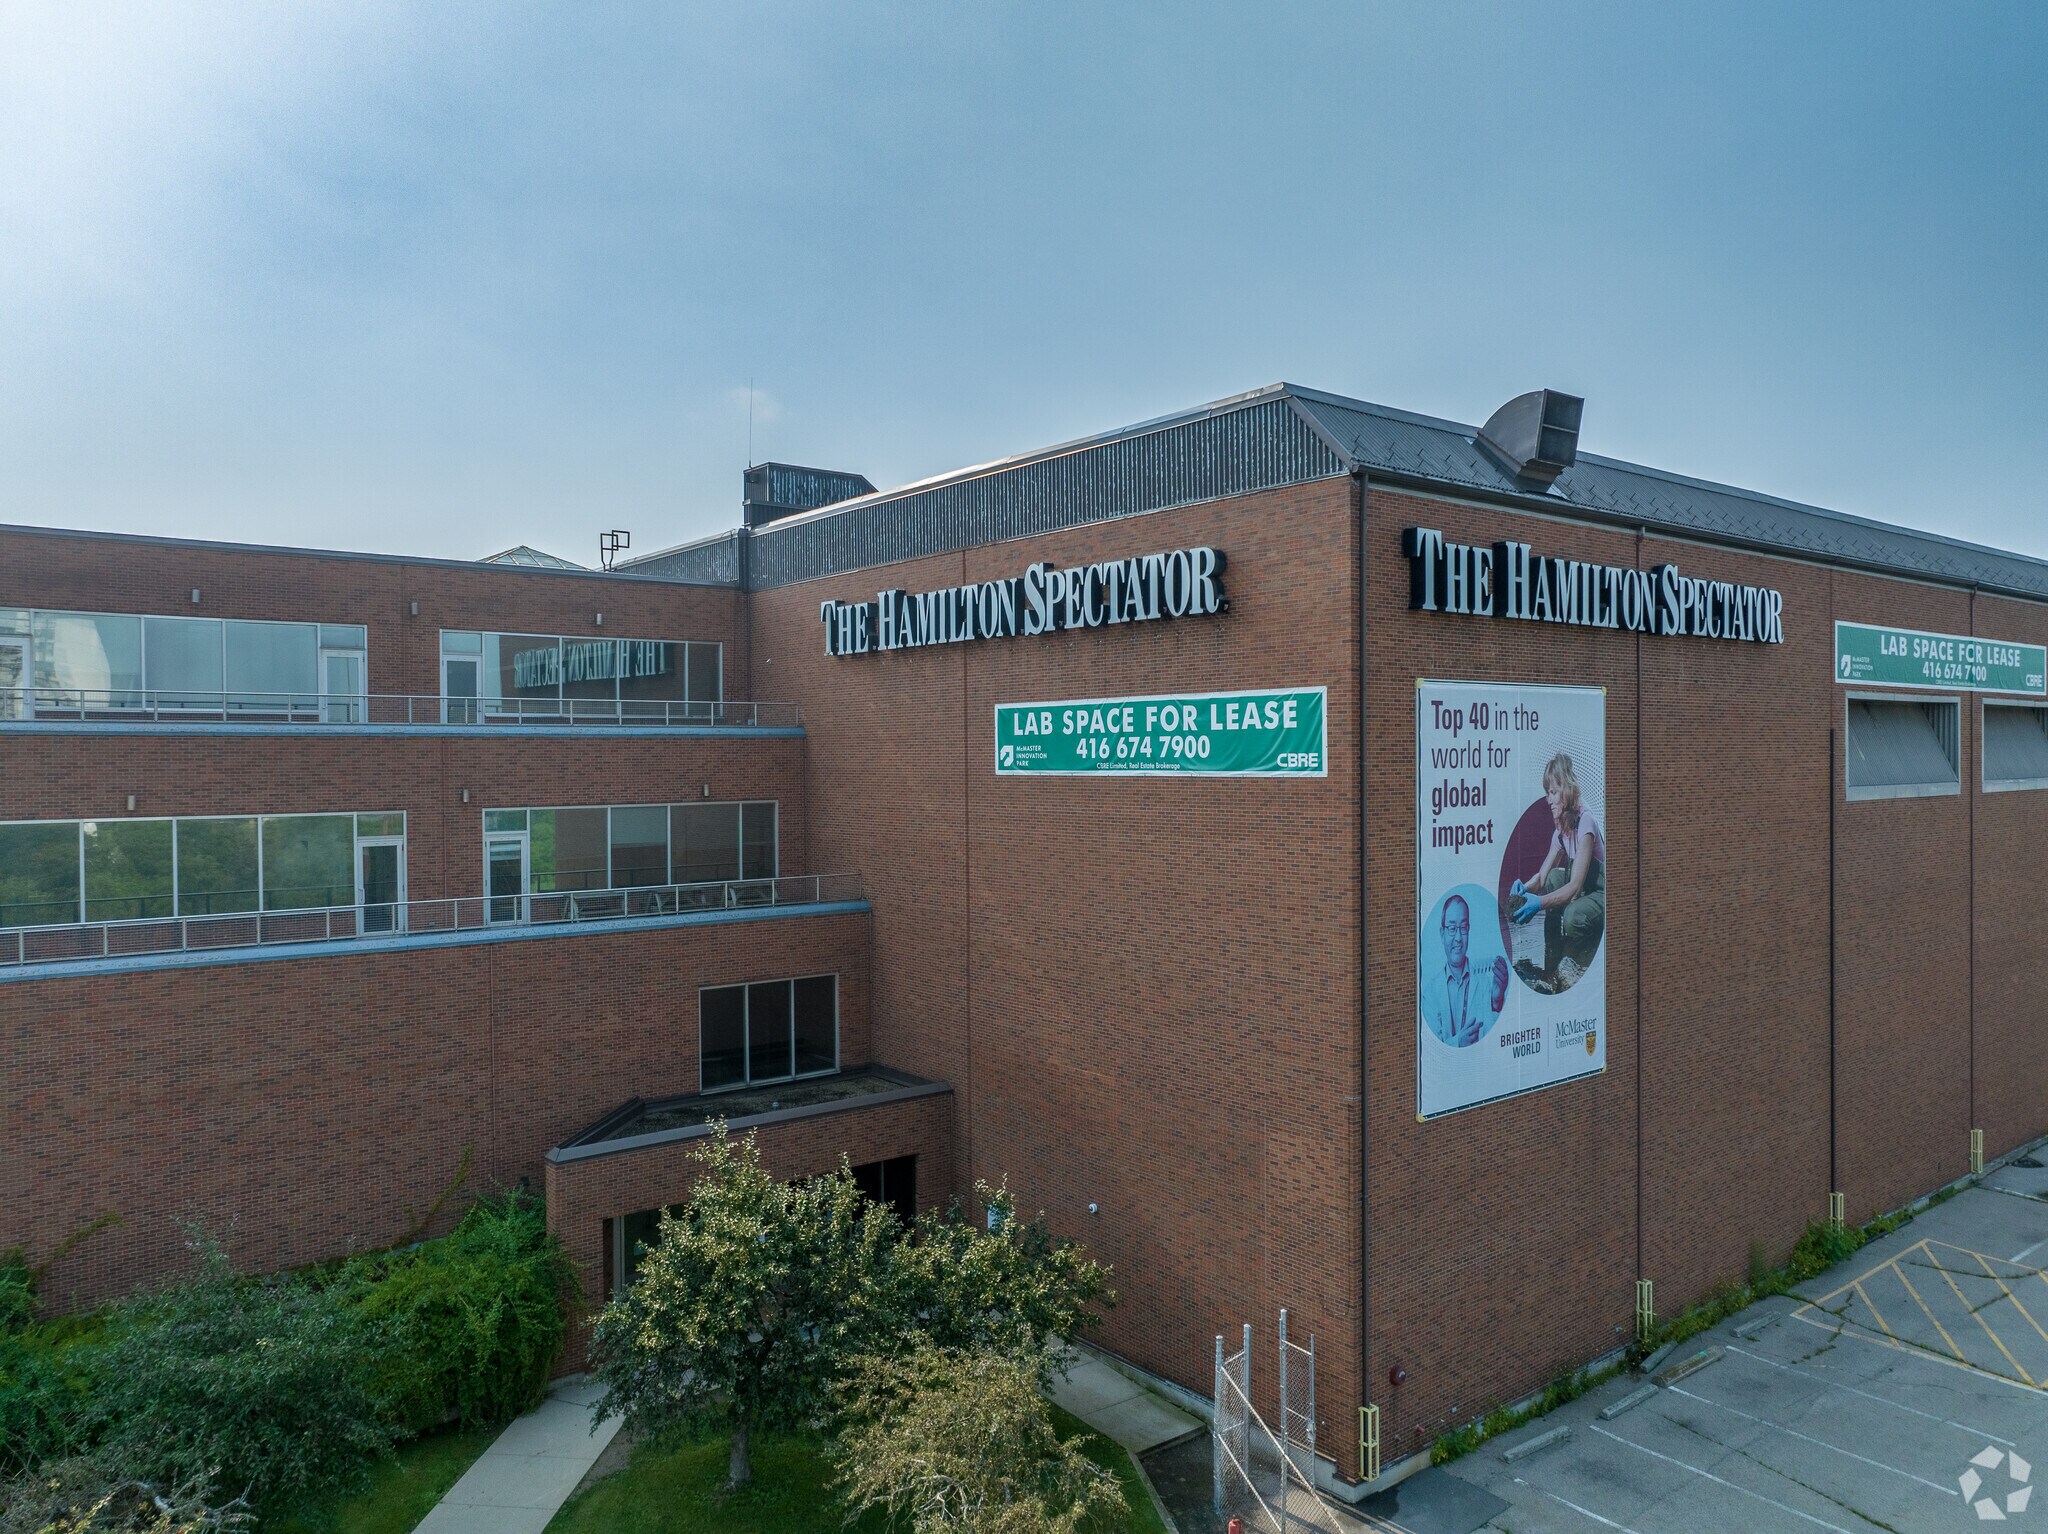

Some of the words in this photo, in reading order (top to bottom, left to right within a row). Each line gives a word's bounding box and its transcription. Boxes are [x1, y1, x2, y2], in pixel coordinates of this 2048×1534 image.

[1416, 527, 1493, 616] THE
[1504, 540, 1657, 634] HAMILTON
[1661, 564, 1784, 644] SPECTATOR
[820, 600, 870, 656] THE
[877, 578, 1017, 651] HAMILTON
[1024, 546, 1221, 636] SPECTATOR
[1881, 634, 1907, 657] LAB
[1913, 638, 1953, 661] SPACE
[1958, 643, 1982, 663] FOR
[1987, 646, 2021, 667] LEASE
[1922, 661, 1942, 679] 416
[1944, 663, 1963, 680] 674
[2026, 674, 2043, 687] CBRE
[1014, 711, 1053, 736] LAB
[1062, 707, 1134, 735] SPACE
[1146, 704, 1198, 732] FOR
[1210, 700, 1298, 731] LEASE
[1431, 700, 1463, 738] Top
[1469, 702, 1489, 730] 40
[1494, 702, 1508, 731] in
[1513, 703, 1539, 731] the
[1076, 736, 1110, 759] 416
[1116, 735, 1152, 759] 674
[1159, 735, 1211, 759] 7900
[1431, 740, 1481, 769] world
[1487, 740, 1511, 768] for
[1129, 761, 1140, 769] Real
[1140, 761, 1155, 769] Estate
[1155, 761, 1180, 770] Brokerage
[1276, 752, 1319, 768] CBRE
[1431, 777, 1487, 816] global
[1432, 818, 1494, 855] impact
[1500, 1027, 1541, 1048] BRIGHTER
[1555, 1018, 1597, 1038] McMaster
[1512, 1041, 1541, 1059] WORLD
[1555, 1035, 1584, 1049] University
